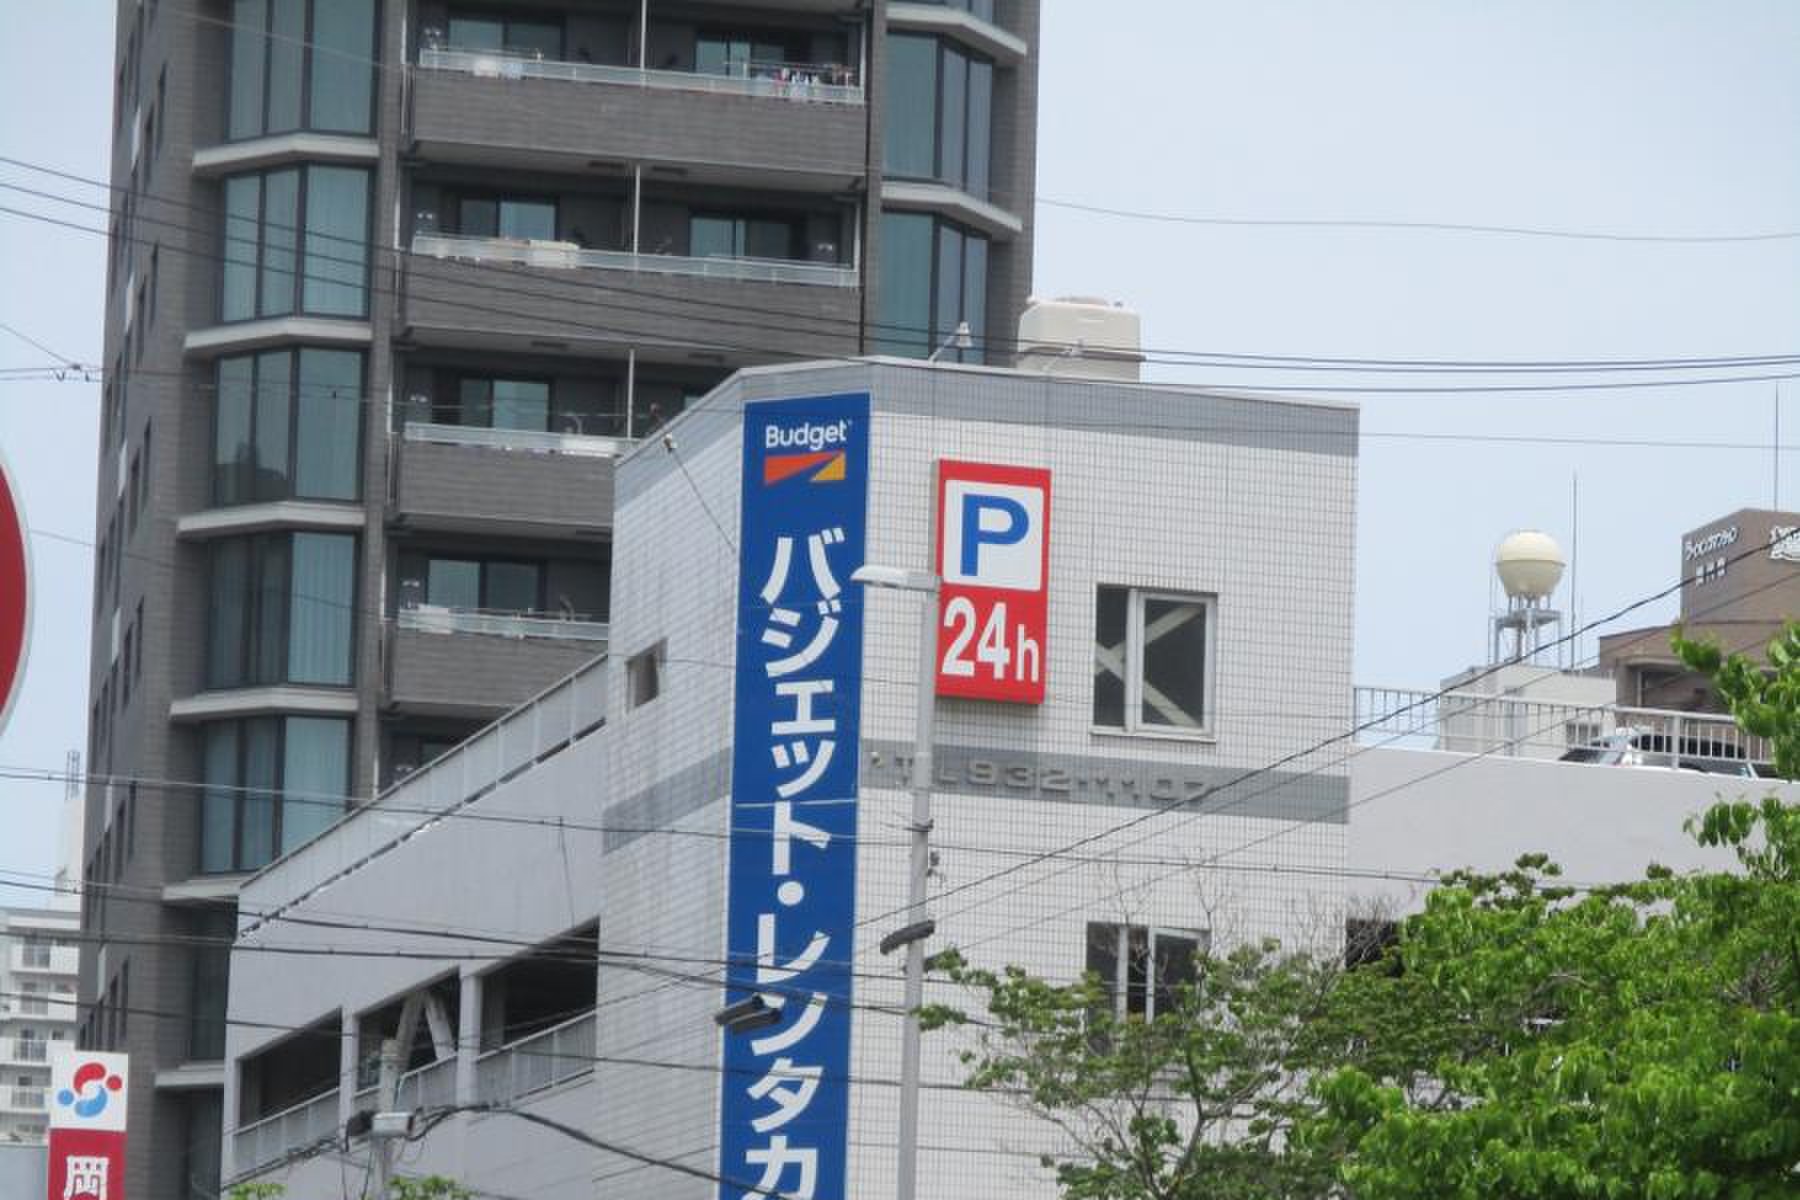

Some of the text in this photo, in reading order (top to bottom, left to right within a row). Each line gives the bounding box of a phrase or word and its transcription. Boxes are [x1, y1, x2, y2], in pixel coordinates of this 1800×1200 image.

[765, 420, 847, 452] Budget
[960, 494, 1030, 577] P
[942, 596, 1040, 682] 24h
